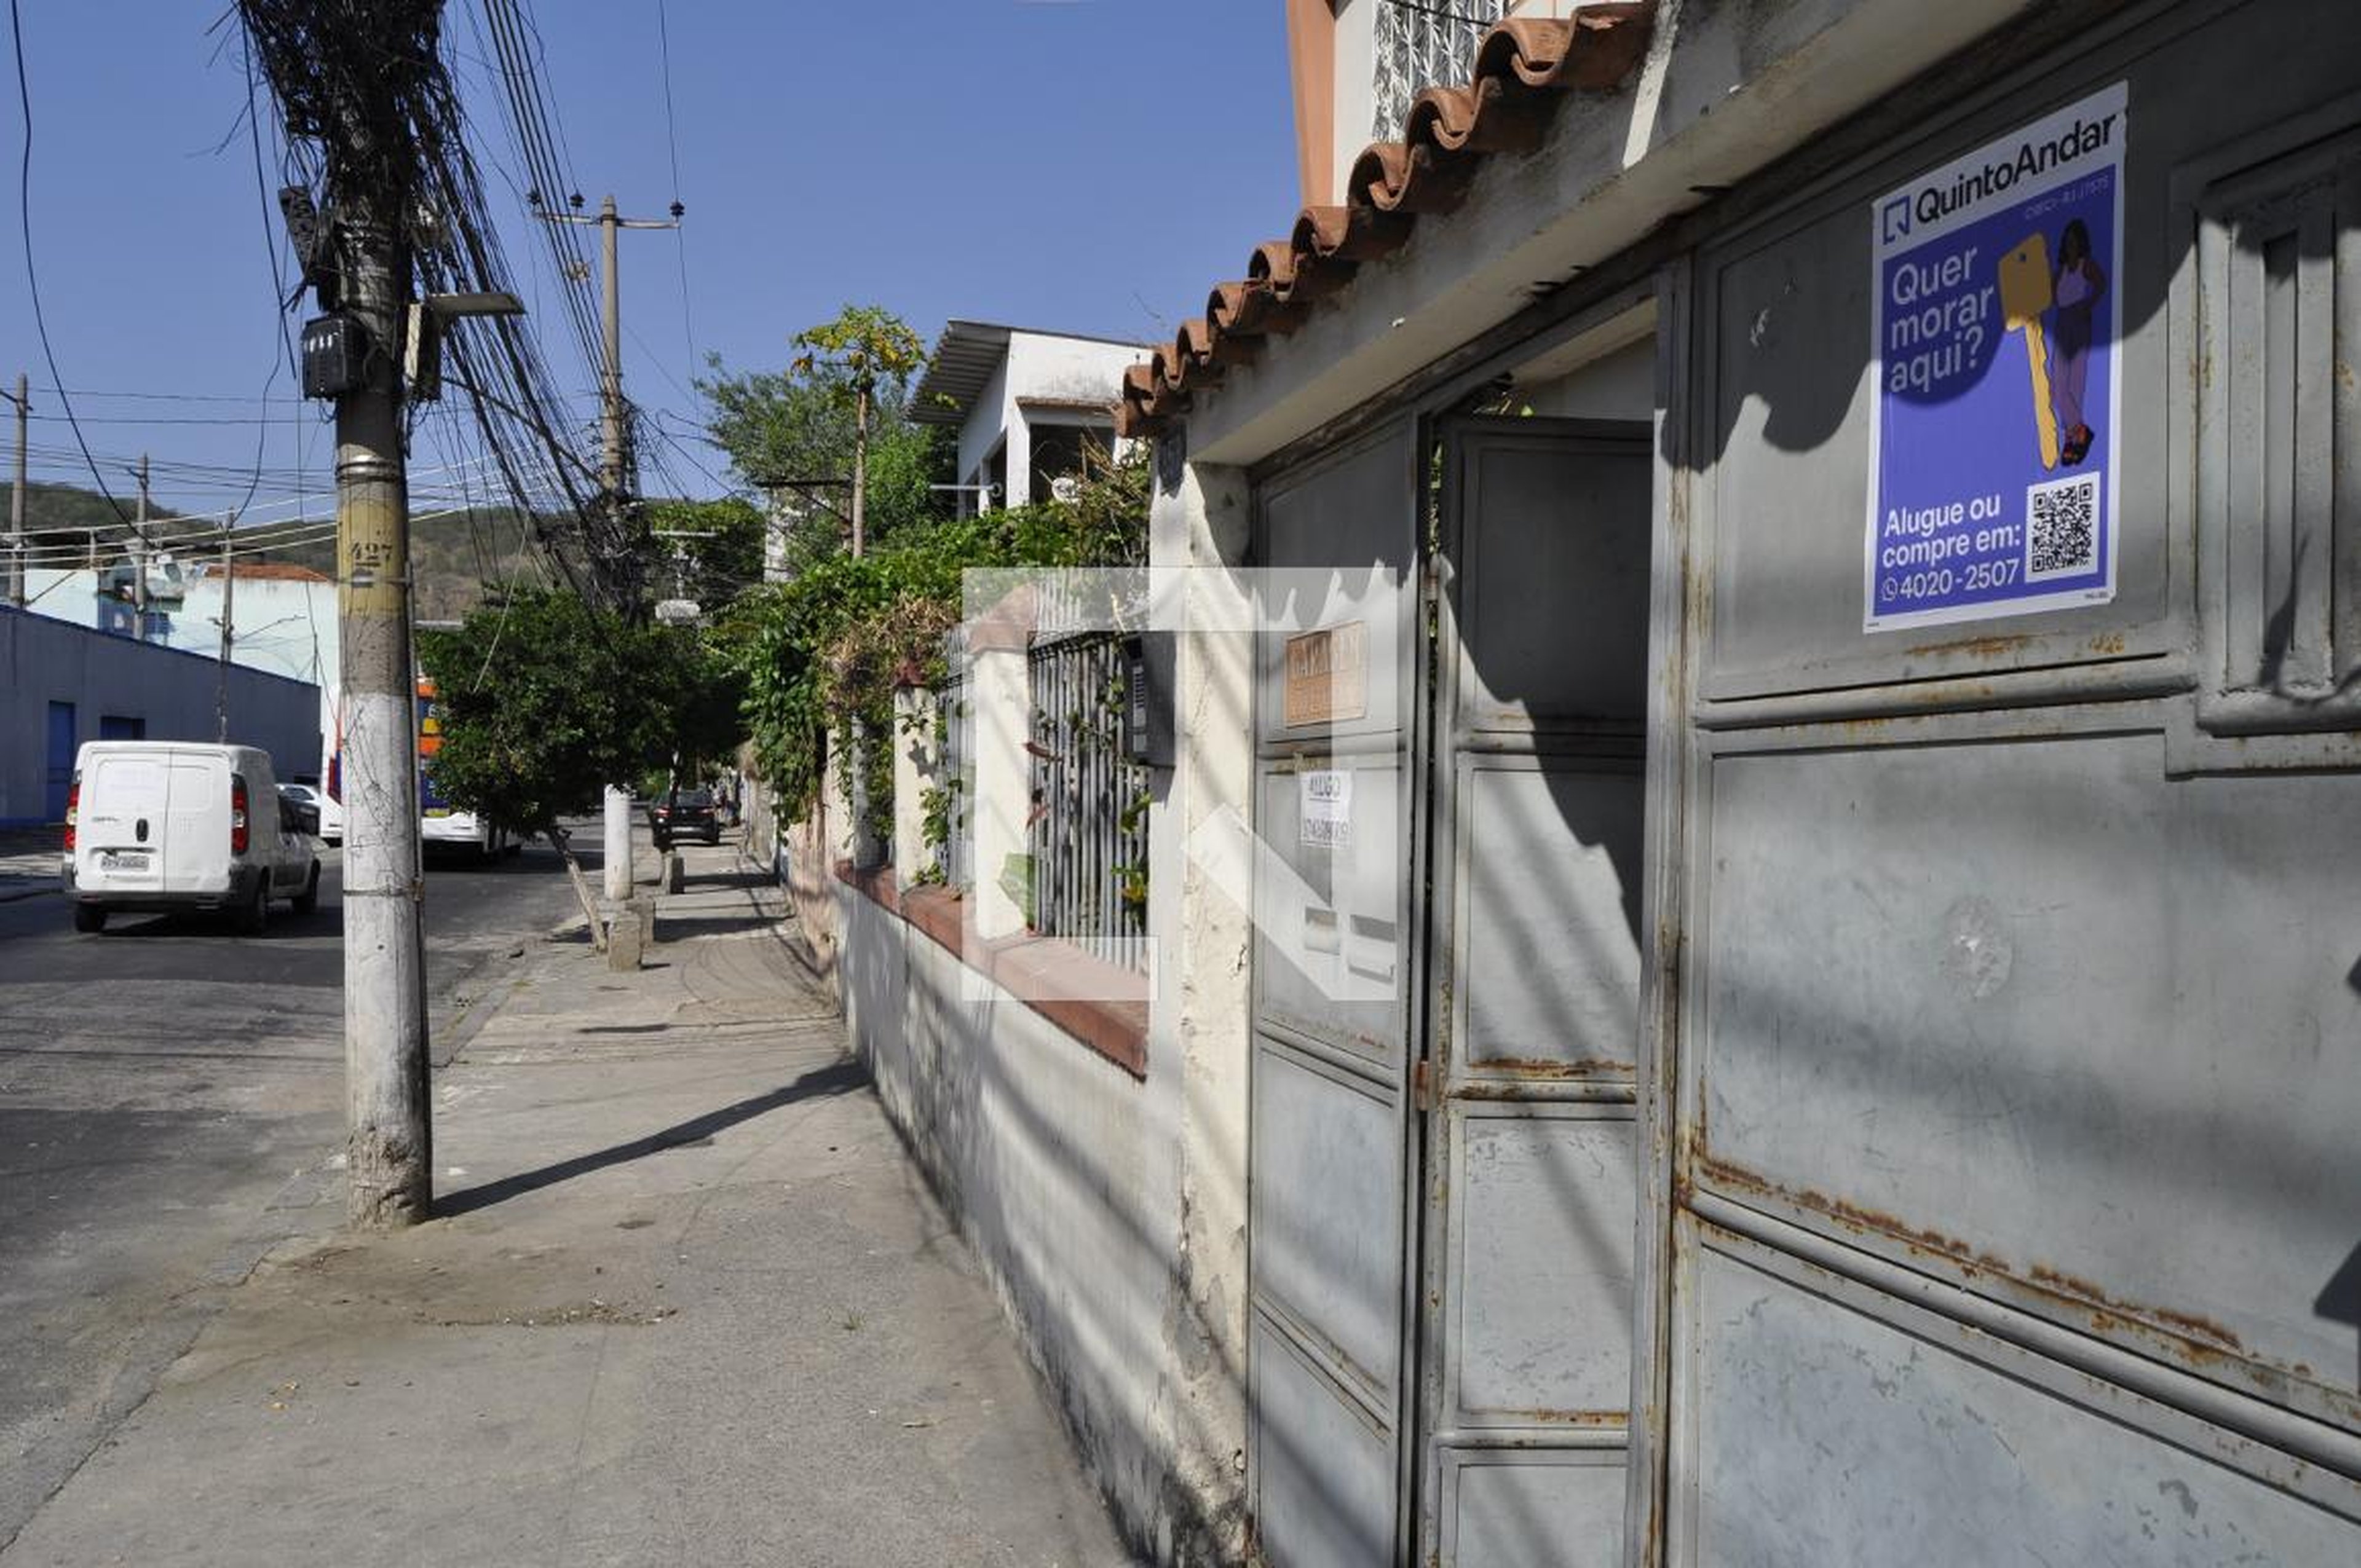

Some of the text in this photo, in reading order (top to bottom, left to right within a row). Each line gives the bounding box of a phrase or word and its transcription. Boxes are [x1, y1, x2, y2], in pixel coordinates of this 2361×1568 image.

[1916, 114, 2116, 225] QuintoAndar
[1892, 246, 1978, 305] Quer
[1891, 285, 1994, 351] morar
[1890, 327, 1984, 393] aqui?
[1882, 524, 2021, 568] compre em:
[1884, 494, 2001, 538] Alugue ou
